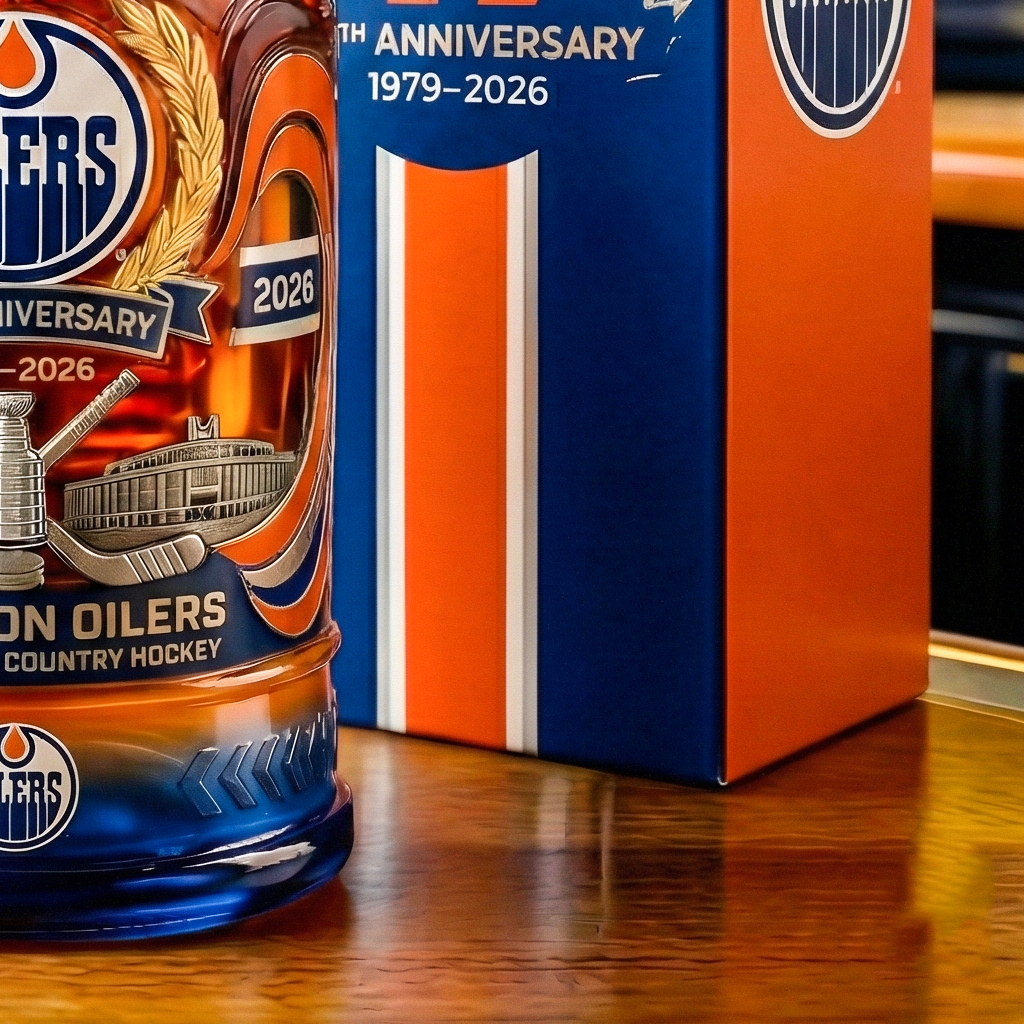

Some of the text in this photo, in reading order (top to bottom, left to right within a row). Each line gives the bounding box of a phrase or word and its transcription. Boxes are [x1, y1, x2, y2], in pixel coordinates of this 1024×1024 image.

[337, 22, 645, 61] TH ANNIVERSARY
[367, 71, 549, 106] 1979–2026
[253, 268, 314, 314] 2026
[72, 591, 226, 640] OILERS
[4, 647, 124, 672] COUNTRY
[130, 637, 223, 668] HOCKEY
